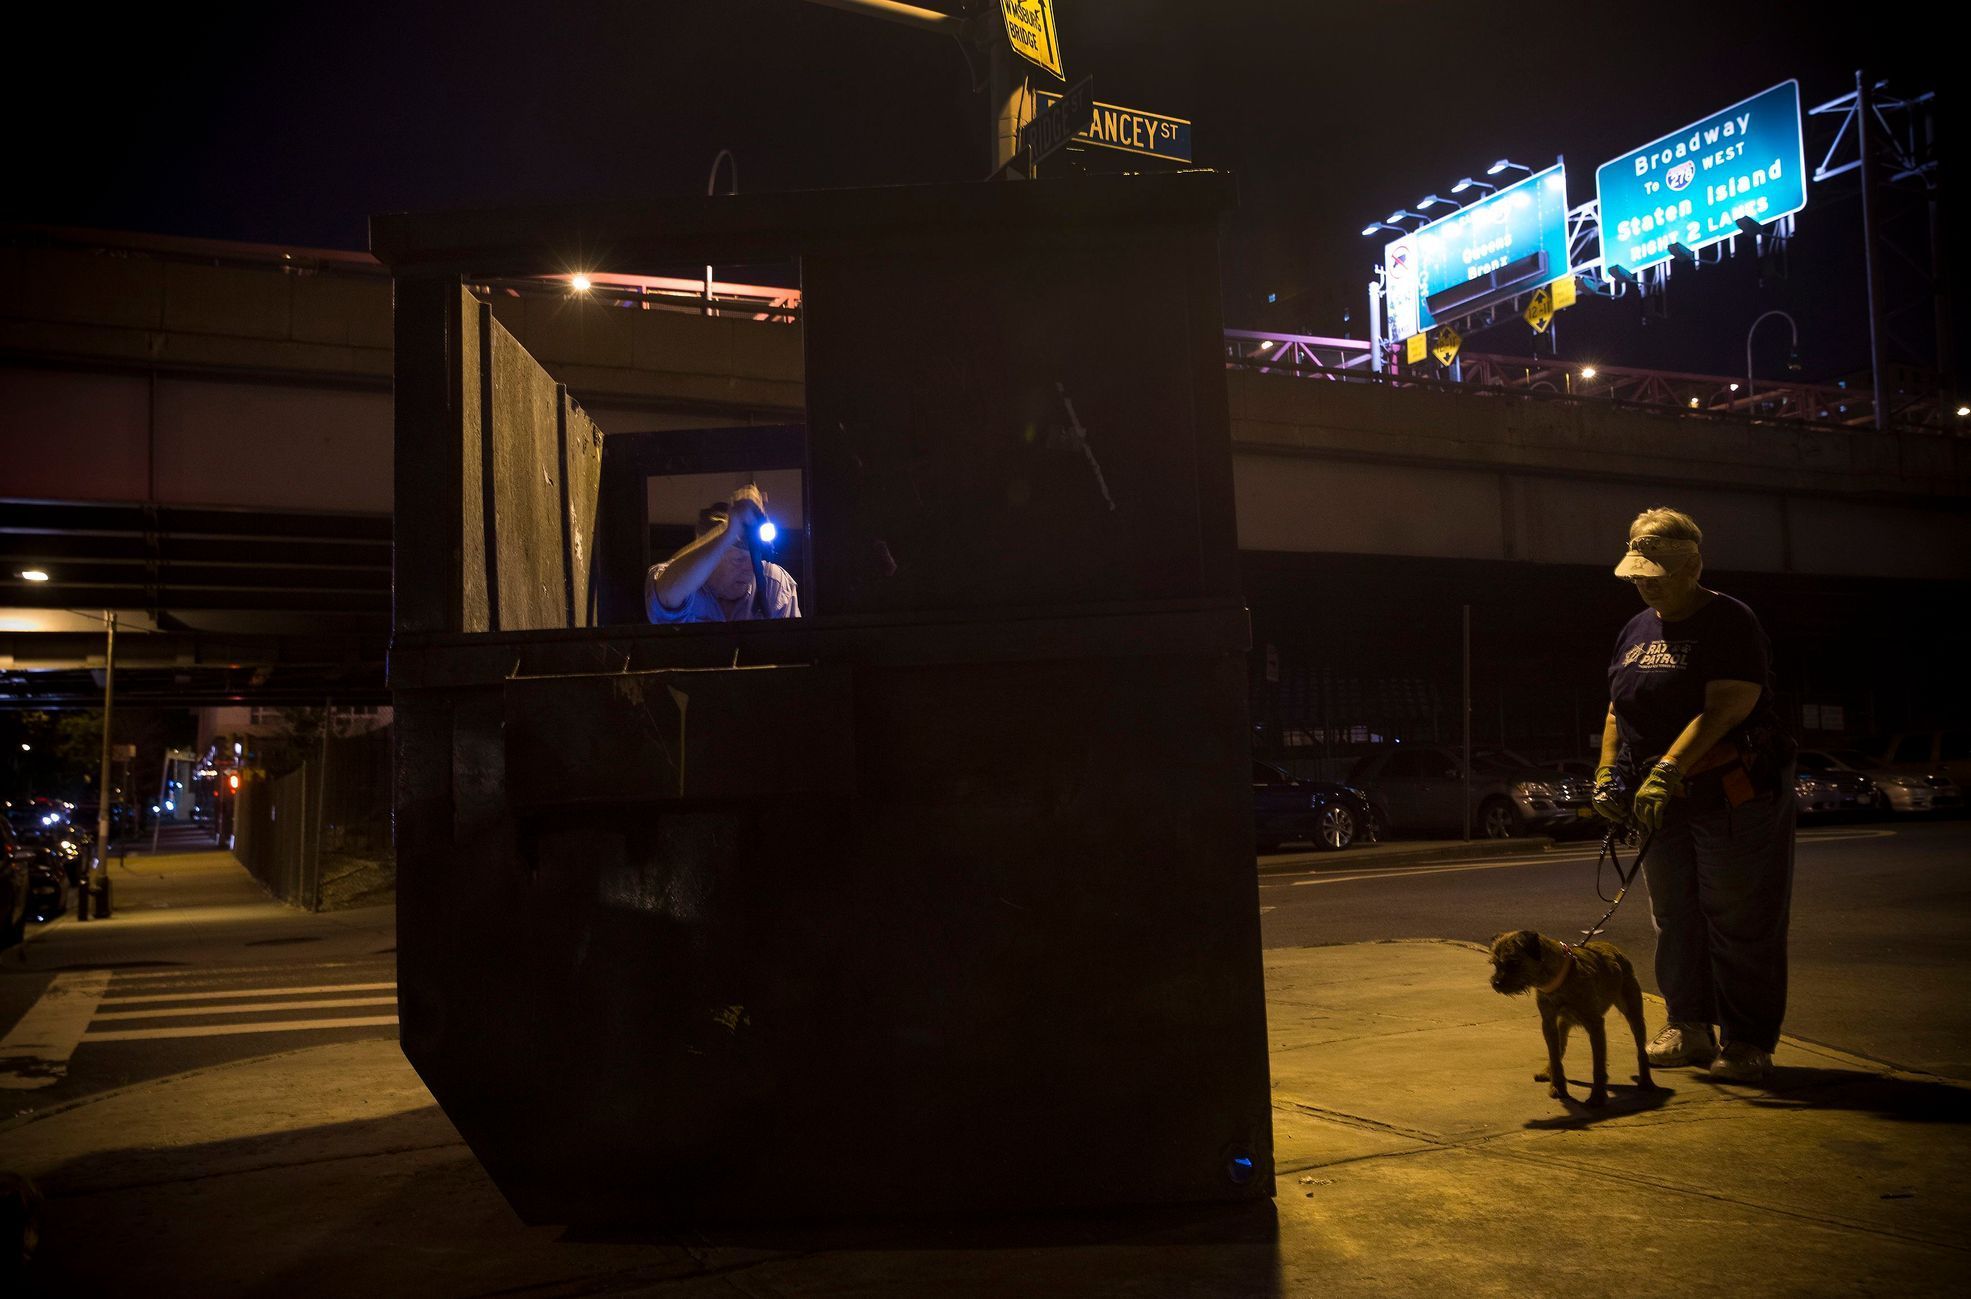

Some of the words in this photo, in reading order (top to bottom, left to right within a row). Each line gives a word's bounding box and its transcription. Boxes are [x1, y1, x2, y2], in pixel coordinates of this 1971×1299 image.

[1009, 21, 1038, 51] BRIDGE
[1160, 122, 1179, 141] ST
[1634, 113, 1750, 177] Broadway
[1644, 180, 1660, 195] To
[1670, 167, 1693, 188] 278
[1701, 142, 1745, 170] WEST
[1617, 199, 1693, 242] Staten
[1706, 158, 1782, 206] Island
[1630, 230, 1679, 262] RIGHT
[1686, 221, 1701, 242] 2
[1707, 196, 1769, 232] LANES
[1468, 256, 1508, 281] Bronx
[1639, 653, 1689, 665] PATROL
[1646, 643, 1668, 655] RAT
